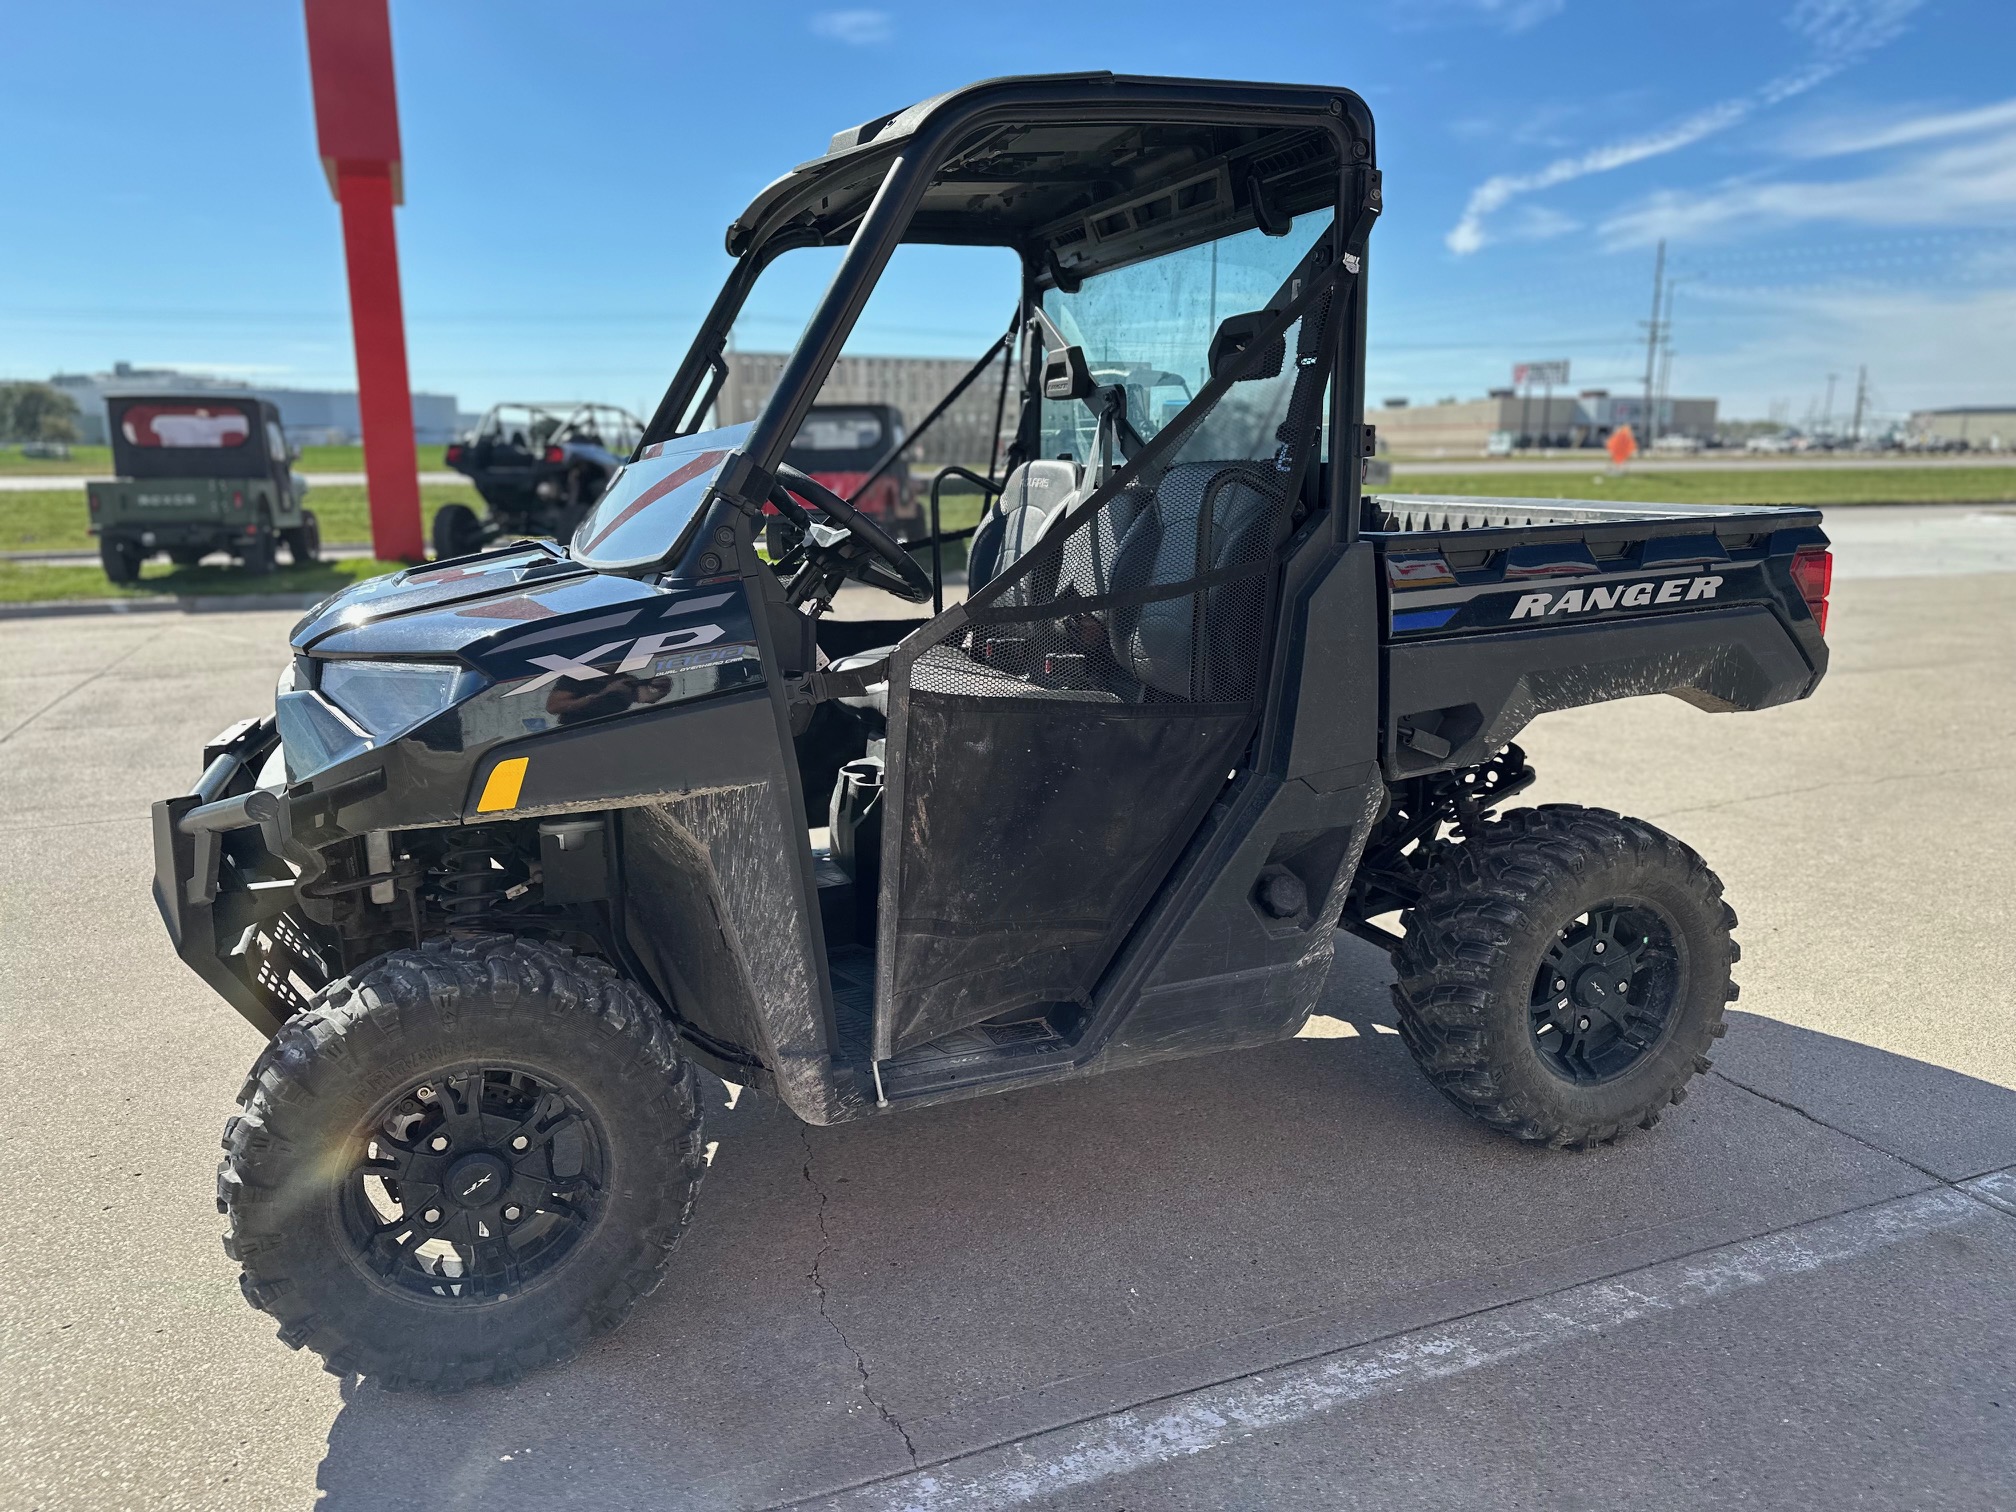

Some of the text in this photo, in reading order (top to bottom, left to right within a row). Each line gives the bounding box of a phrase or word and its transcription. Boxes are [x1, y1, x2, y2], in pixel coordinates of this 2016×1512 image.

[1509, 576, 1723, 620] RANGER
[500, 624, 726, 699] XP
[655, 646, 745, 671] 1000
[655, 656, 744, 677] DUAL OVERHEAD CAM
[1590, 981, 1605, 995] XP
[462, 1173, 492, 1196] XP
